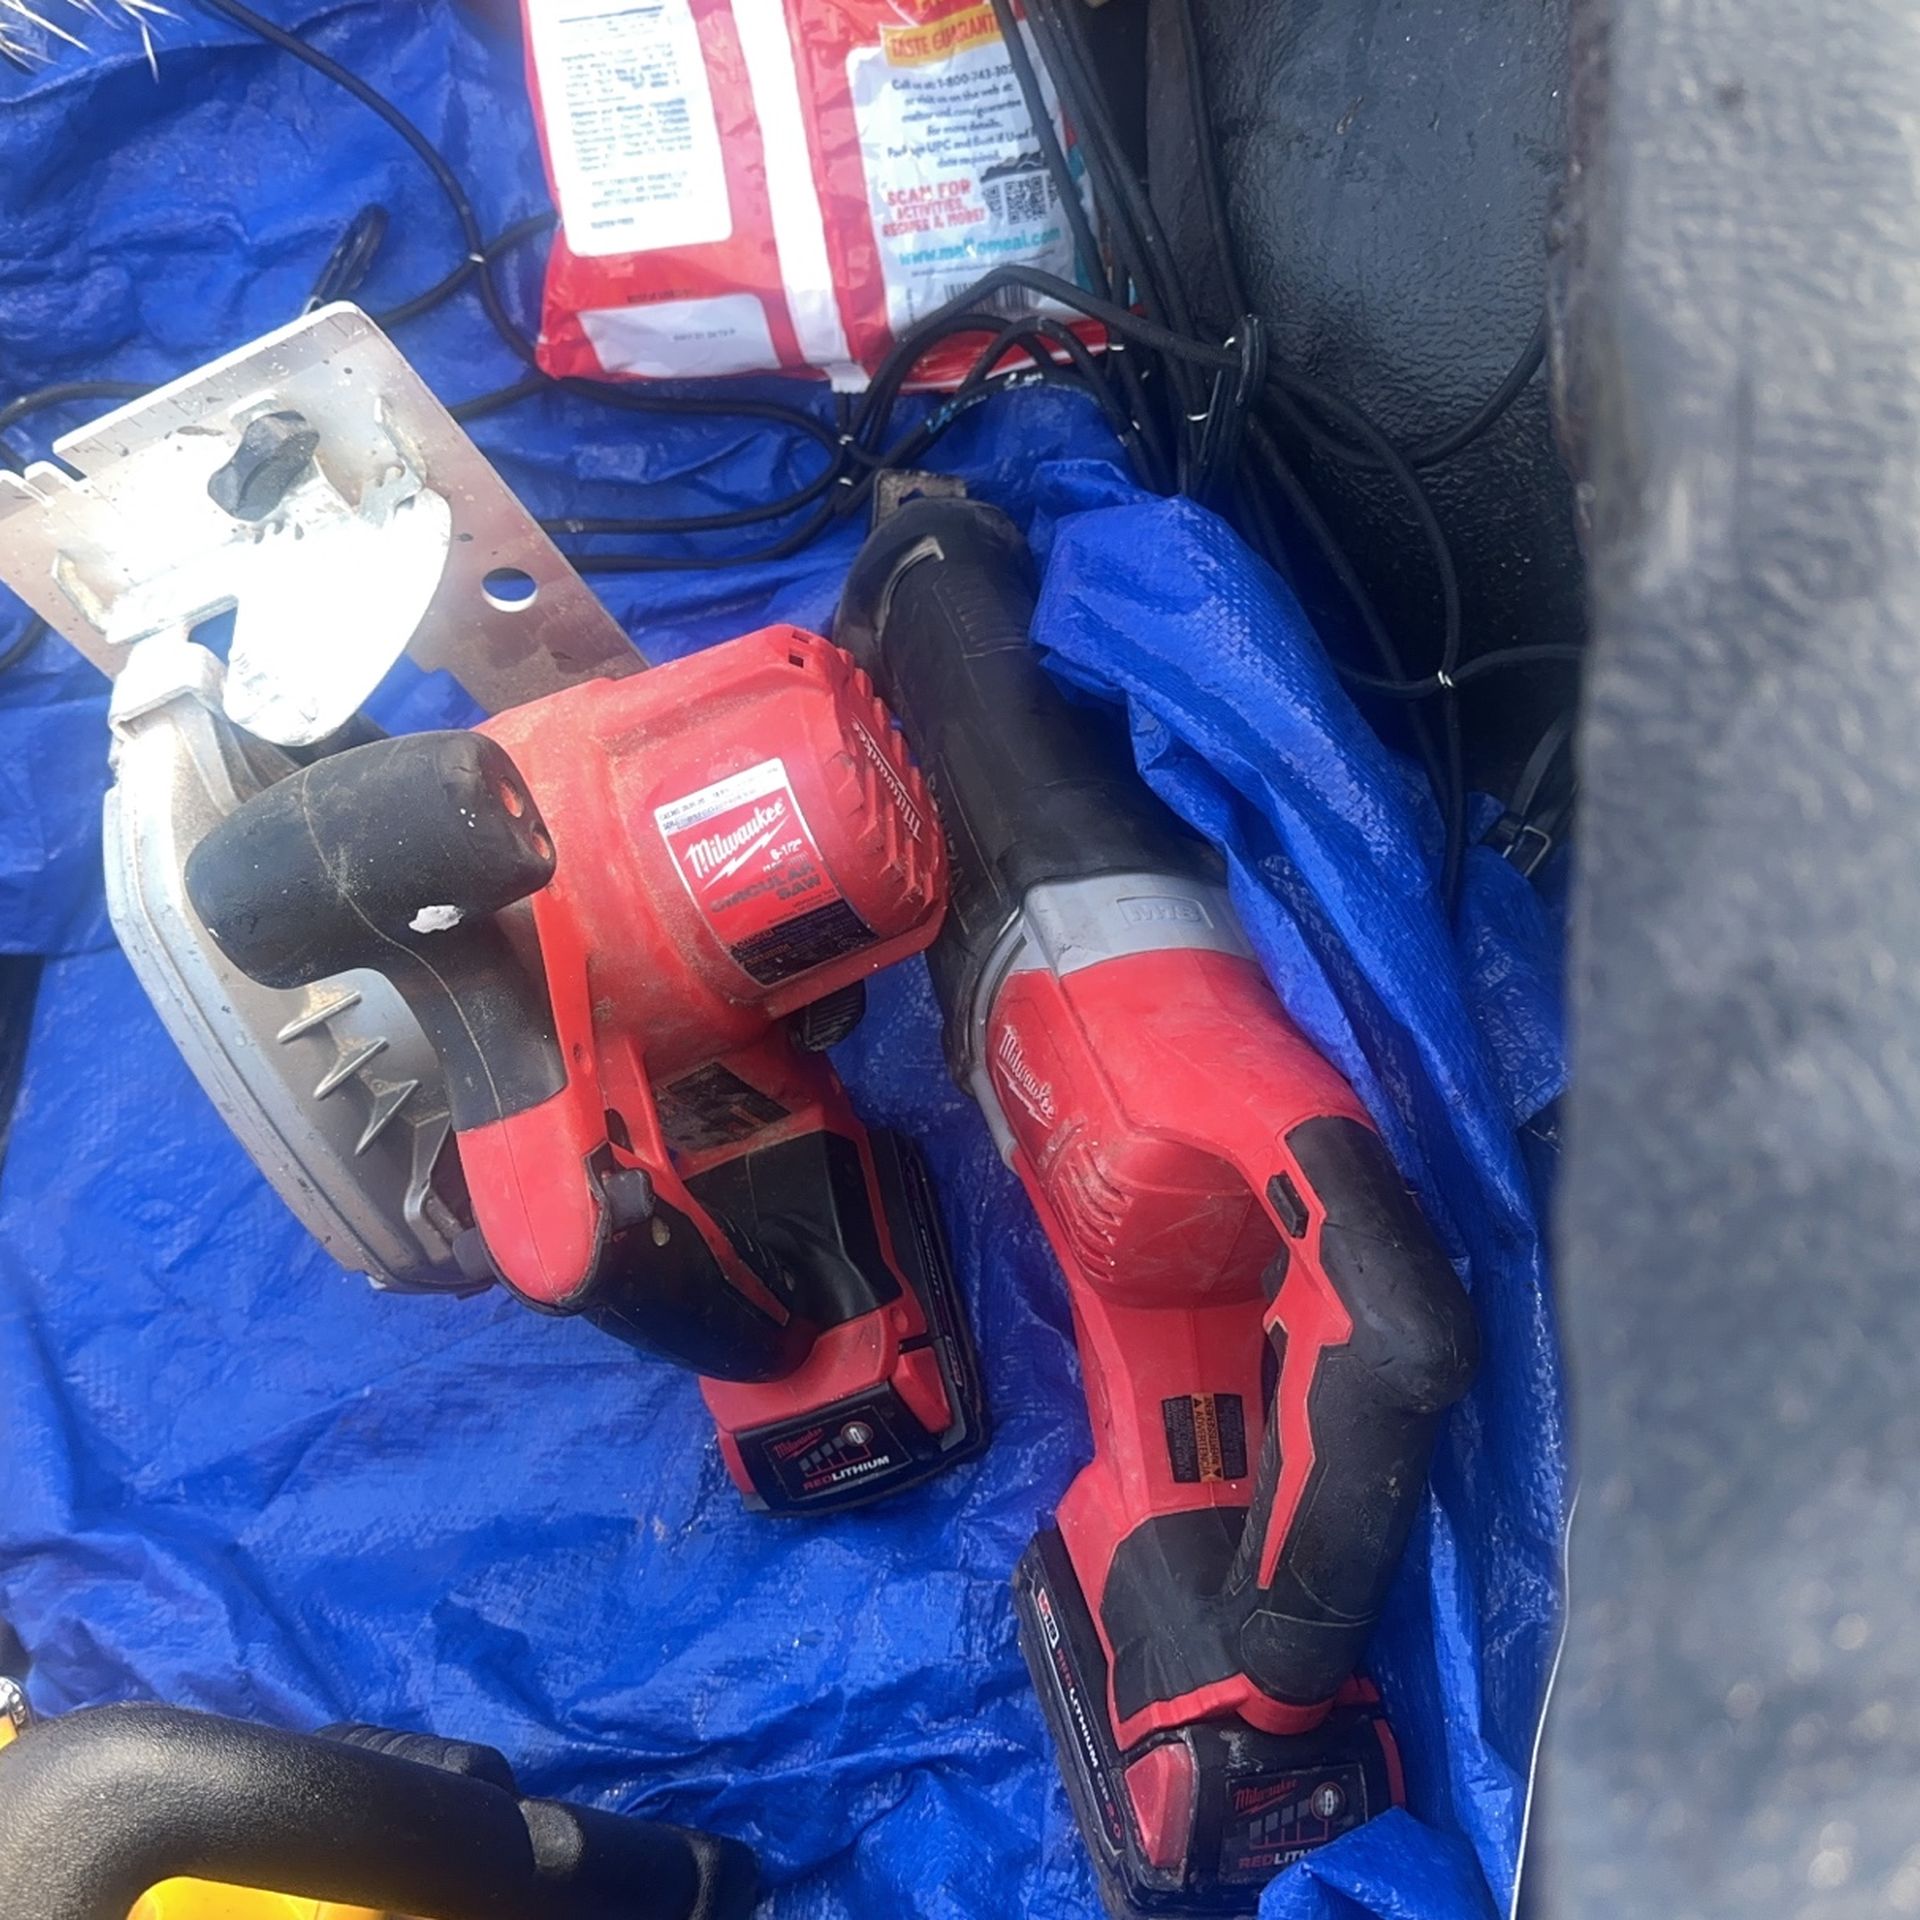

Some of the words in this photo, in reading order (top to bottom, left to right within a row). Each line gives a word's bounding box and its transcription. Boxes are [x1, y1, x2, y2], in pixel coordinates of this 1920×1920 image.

[932, 13, 998, 51] GUARANT
[927, 138, 951, 153] UPC
[937, 178, 972, 198] FOR
[852, 721, 922, 843] Milwaukee
[684, 797, 787, 879] Milwaukee
[777, 874, 821, 900] SAW
[1132, 901, 1202, 924] M18
[999, 1023, 1056, 1119] Milwaukee
[1234, 1779, 1297, 1811] Milwaukee
